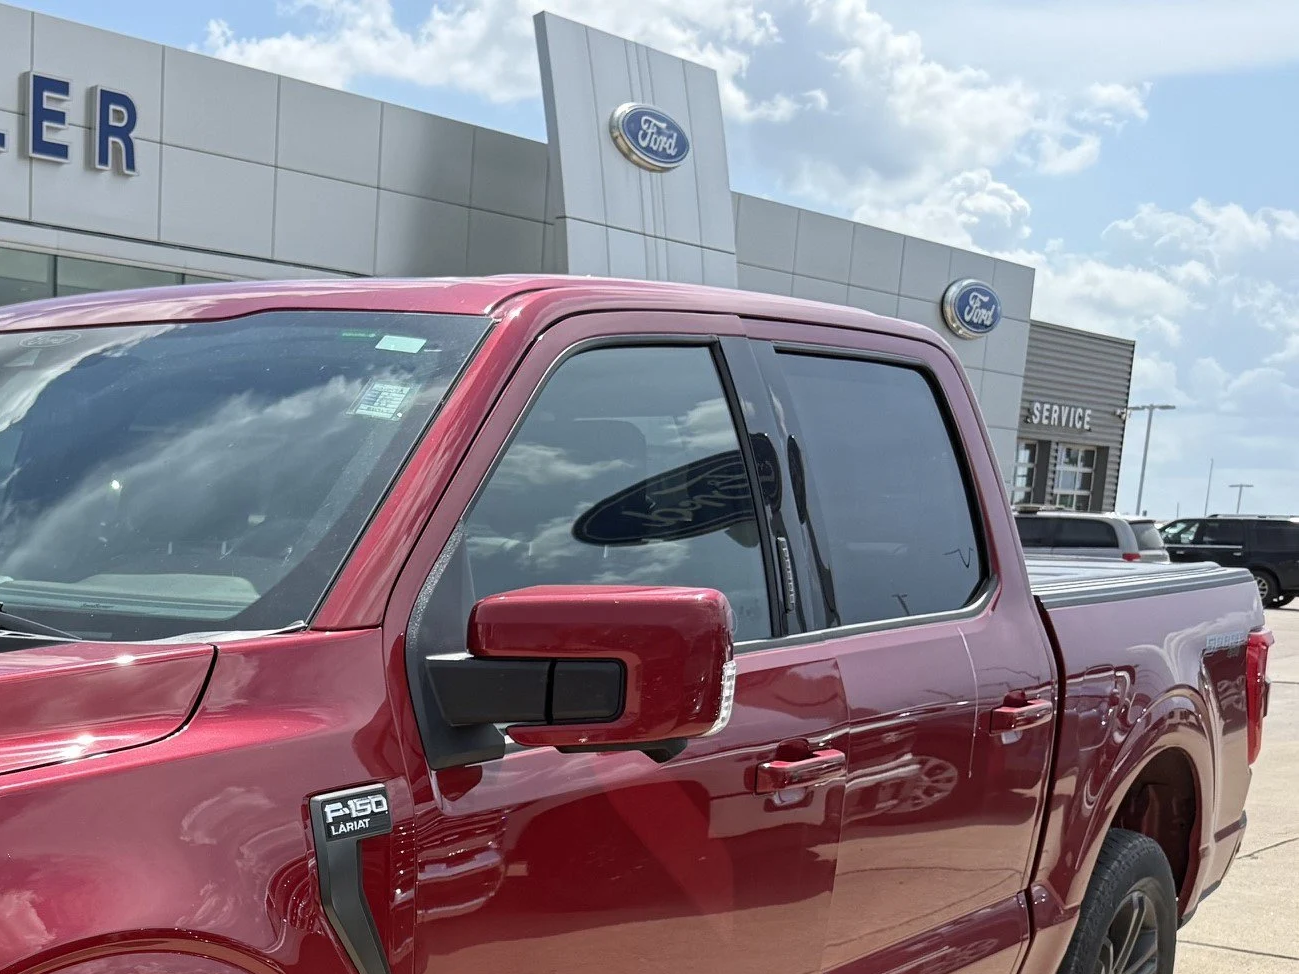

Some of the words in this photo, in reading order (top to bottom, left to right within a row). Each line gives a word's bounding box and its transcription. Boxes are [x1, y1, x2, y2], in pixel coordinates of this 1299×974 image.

[637, 115, 679, 157] Ford
[964, 291, 996, 327] Ford
[1032, 401, 1092, 430] SERVICE
[324, 794, 388, 823] F-150
[330, 818, 371, 836] LARIAT
